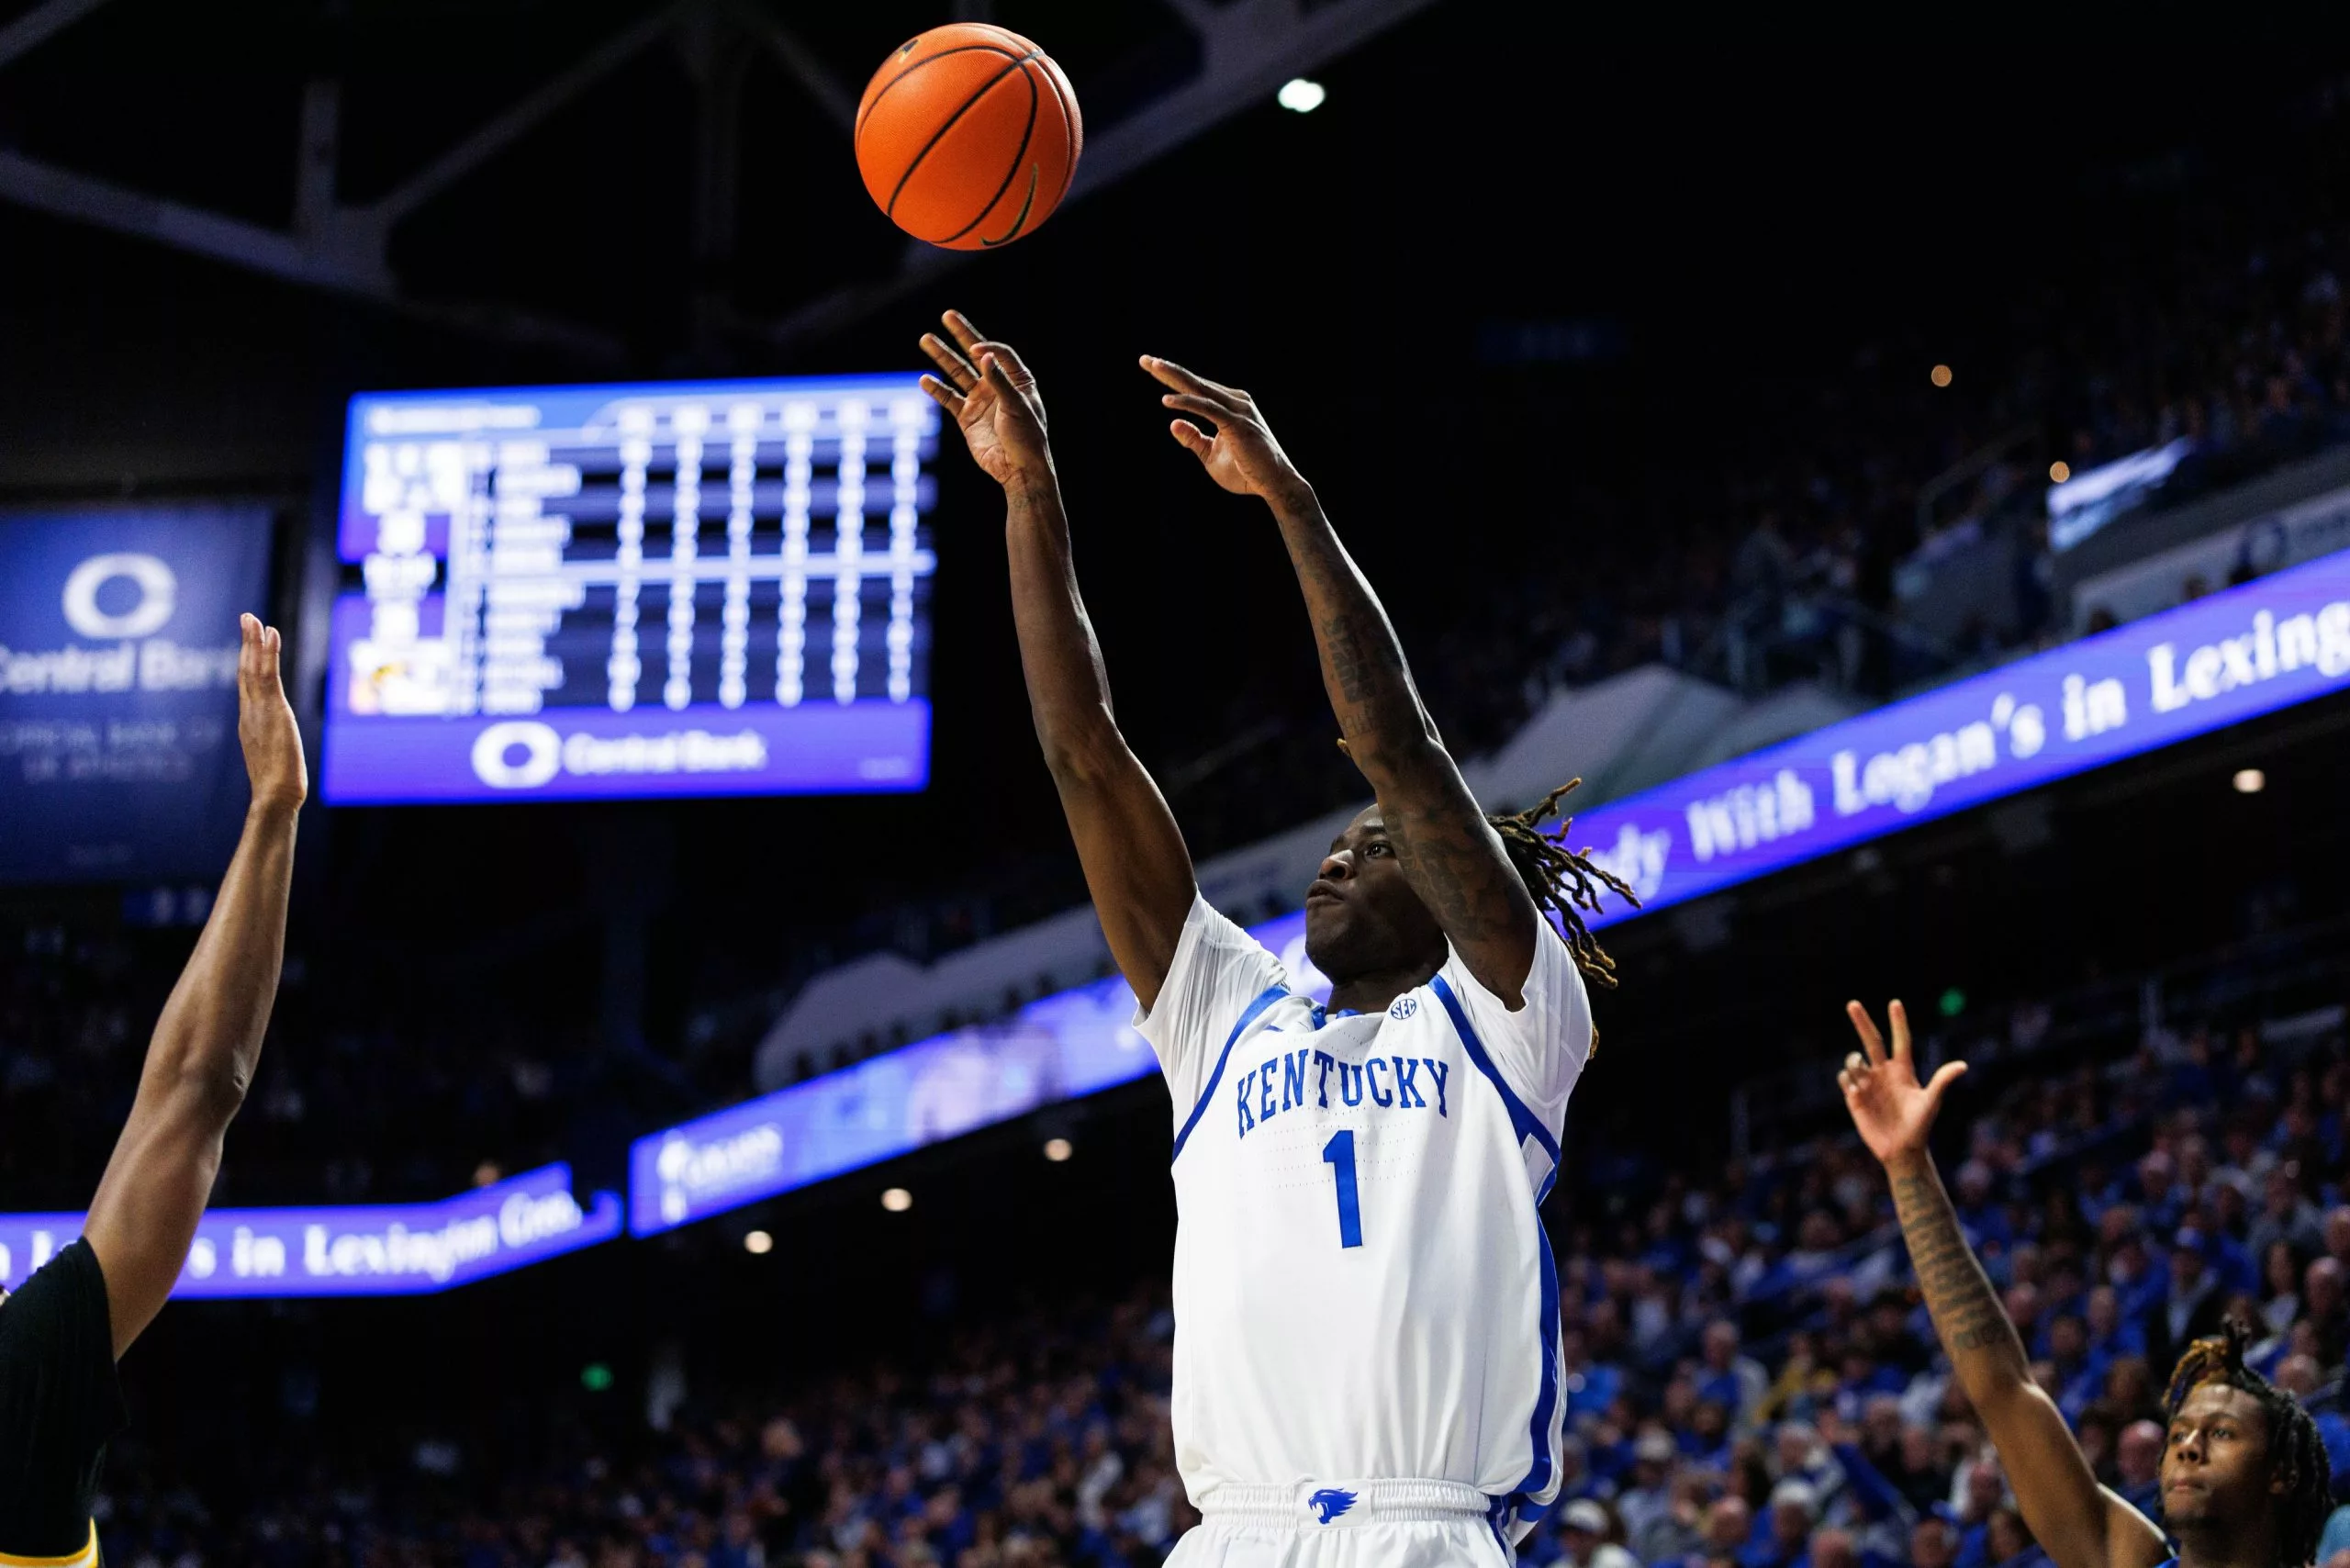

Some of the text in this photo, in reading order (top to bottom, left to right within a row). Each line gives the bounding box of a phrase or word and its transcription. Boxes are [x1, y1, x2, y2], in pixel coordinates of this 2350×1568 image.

[0, 642, 137, 693] entral
[1687, 769, 1814, 862] With
[1832, 692, 2045, 815] Logan's
[2063, 674, 2126, 742] in
[2148, 602, 2350, 712] Lexing
[1391, 999, 1417, 1020] SEC
[1237, 1048, 1449, 1139] KENTUCKY
[1323, 1130, 1362, 1249] 1
[233, 1226, 285, 1277] in
